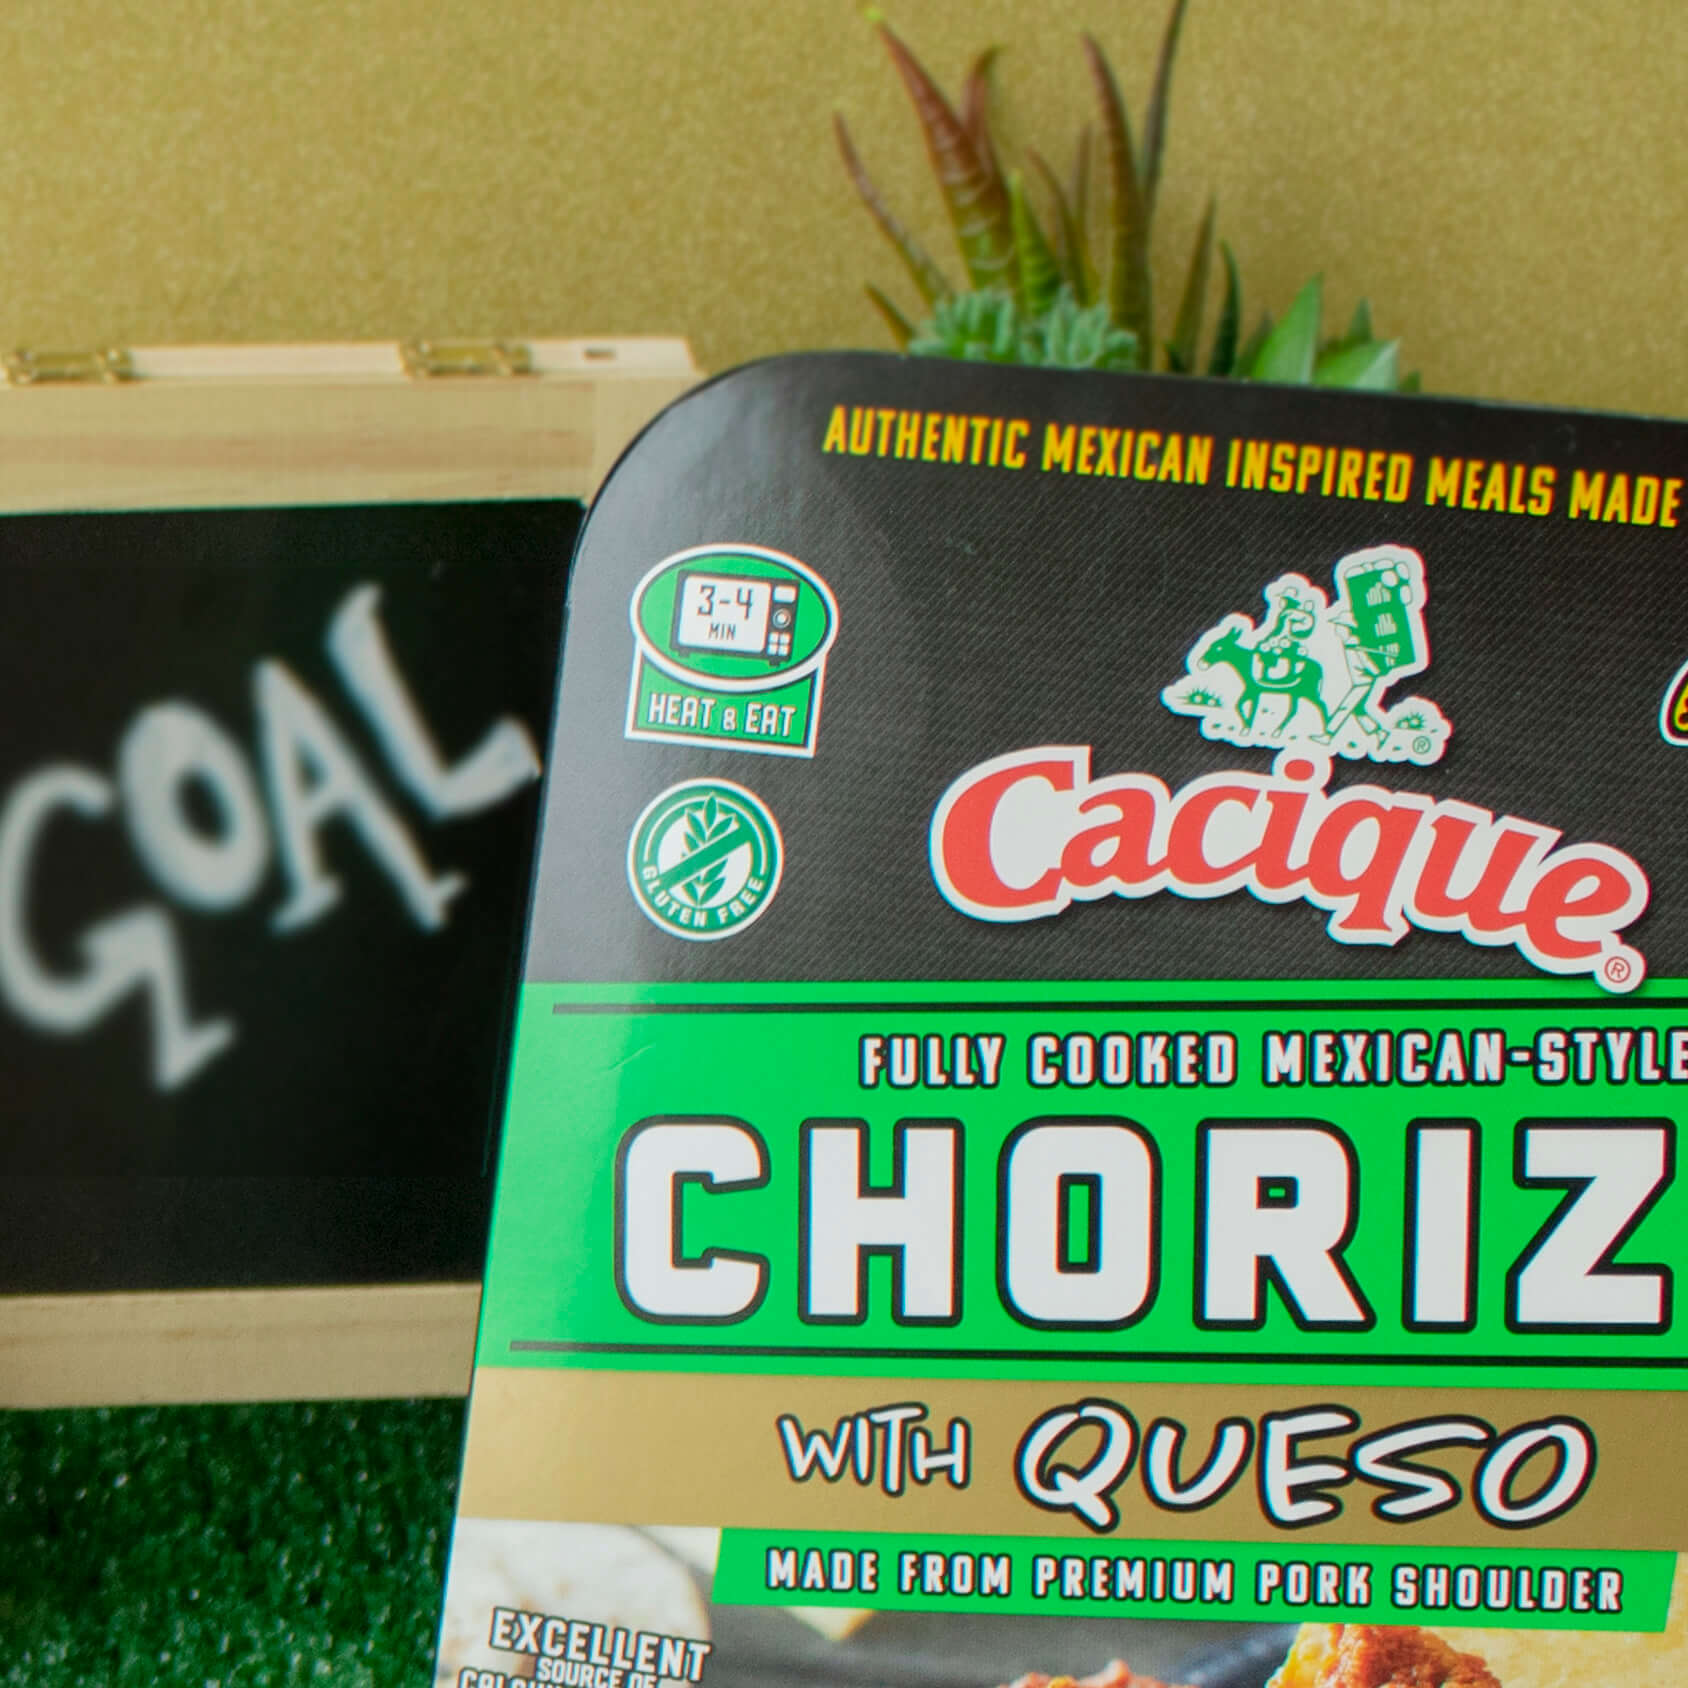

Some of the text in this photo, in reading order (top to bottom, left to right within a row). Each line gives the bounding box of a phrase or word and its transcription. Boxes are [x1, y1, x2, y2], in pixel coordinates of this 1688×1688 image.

[821, 405, 1686, 528] AUTHENTIC MEXICAN INSPIRED MEALS MADE
[696, 584, 754, 620] 3-4
[708, 622, 737, 640] MIN
[648, 693, 797, 737] HEAT & EAT
[641, 859, 765, 928] GLUTEN FREE
[936, 752, 1640, 966] Cacique
[861, 1030, 1688, 1087] FULLY COOKED MEXICAN-STYLE
[618, 1115, 1674, 1333] CHORIZ
[778, 1399, 1597, 1531] WITH QUESO
[766, 1548, 1624, 1614] MADE FROM PREMIUM PORK SHOULDER
[490, 1607, 712, 1682] EXCELLENT
